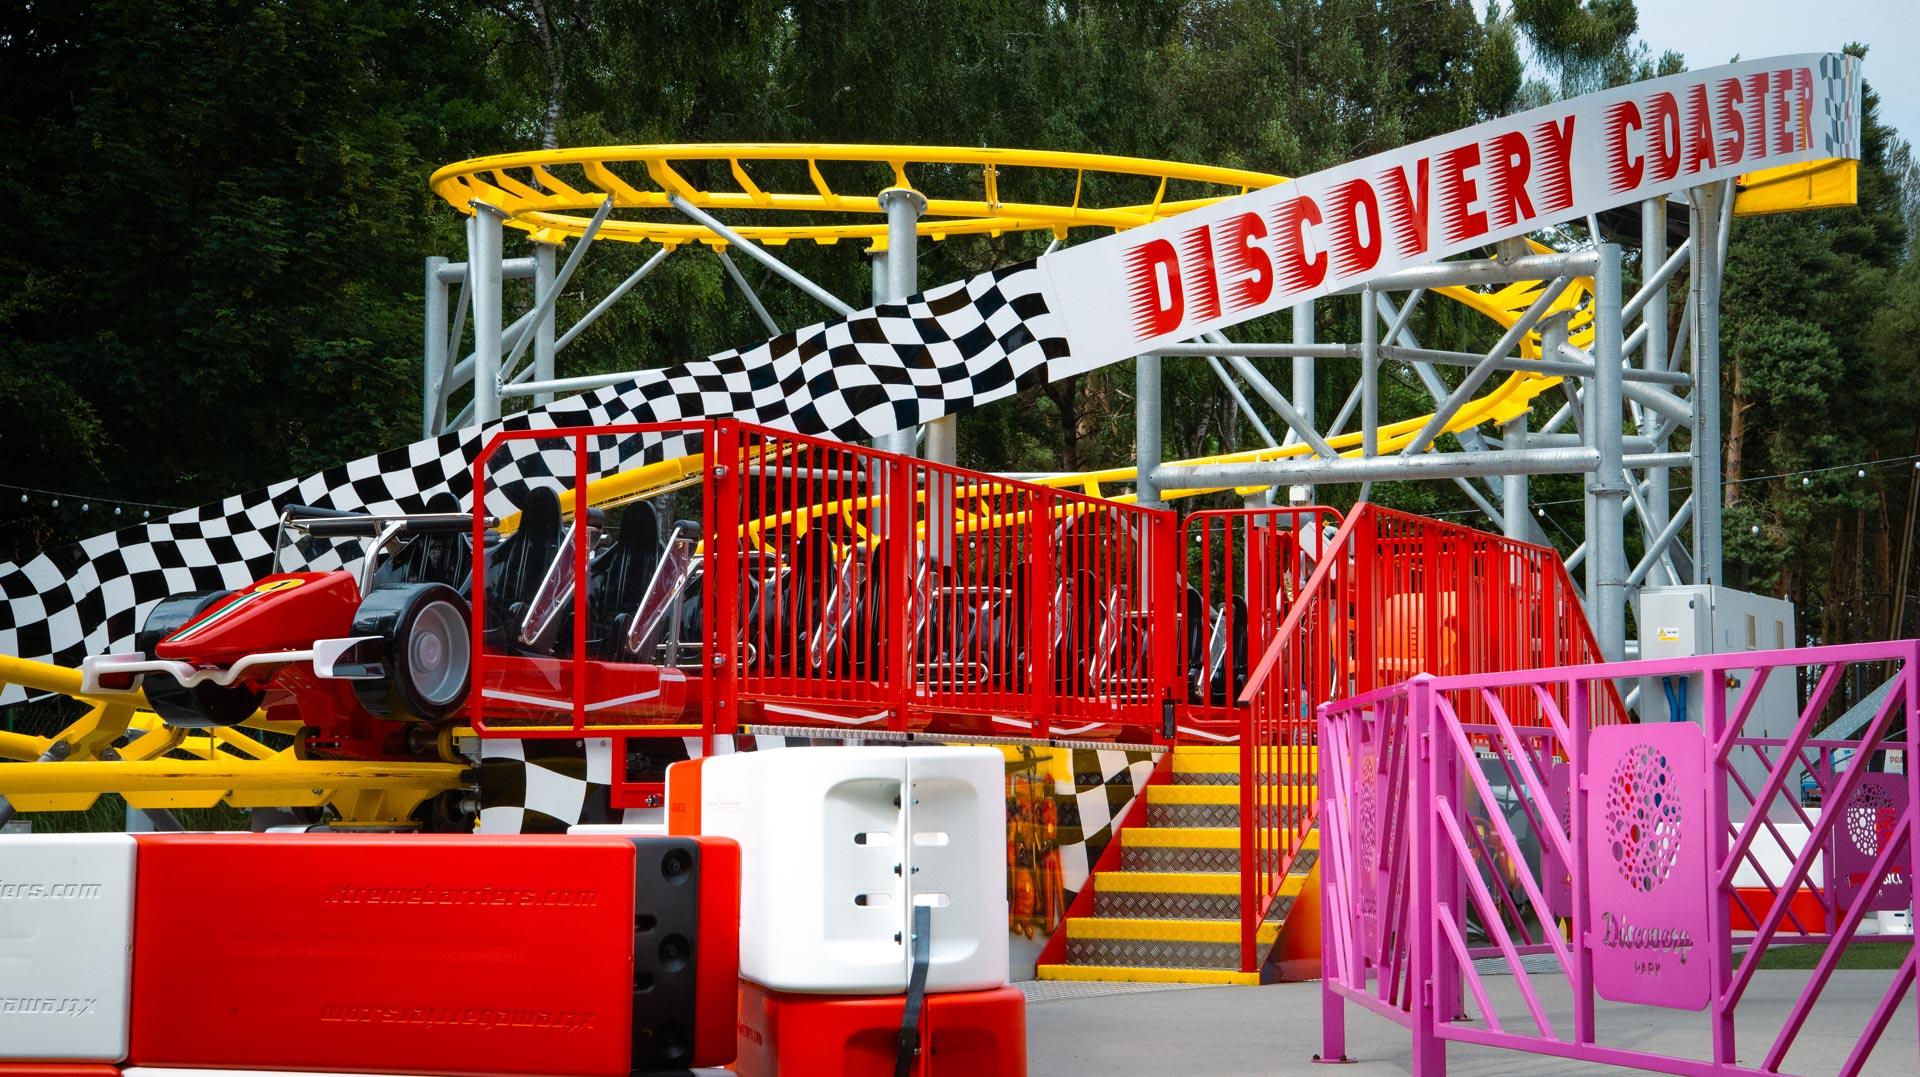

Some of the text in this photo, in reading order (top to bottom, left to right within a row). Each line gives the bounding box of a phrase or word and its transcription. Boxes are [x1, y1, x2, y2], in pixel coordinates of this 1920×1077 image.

[1123, 67, 1815, 343] DISCOVERY COASTER
[1601, 911, 1693, 965] Discovery
[1634, 961, 1661, 976] PARK
